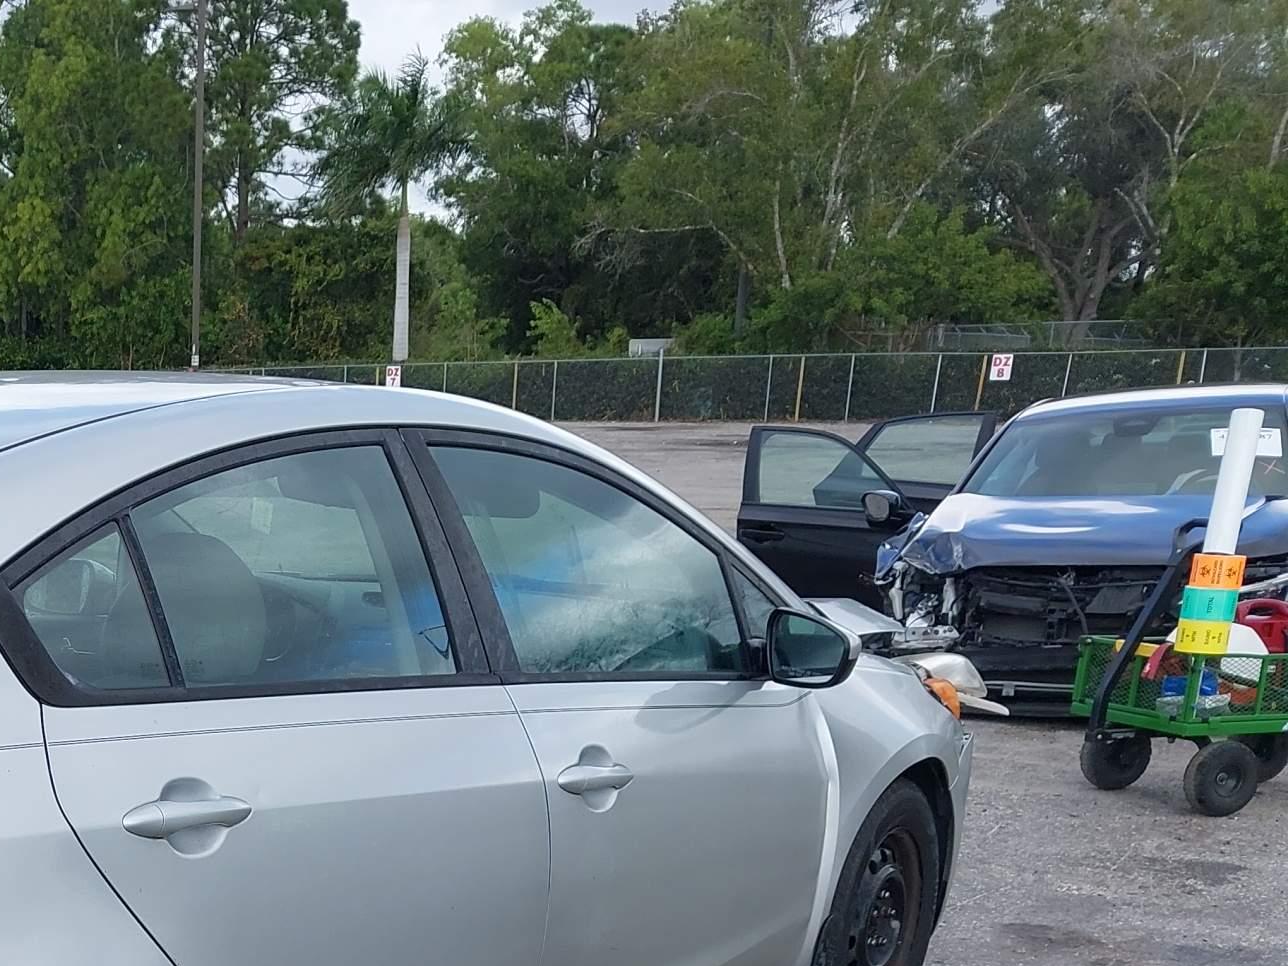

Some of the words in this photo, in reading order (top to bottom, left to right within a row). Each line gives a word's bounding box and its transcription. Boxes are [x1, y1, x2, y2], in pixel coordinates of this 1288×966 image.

[993, 356, 1011, 367] DZ
[387, 368, 399, 377] DZ
[390, 377, 397, 386] 7
